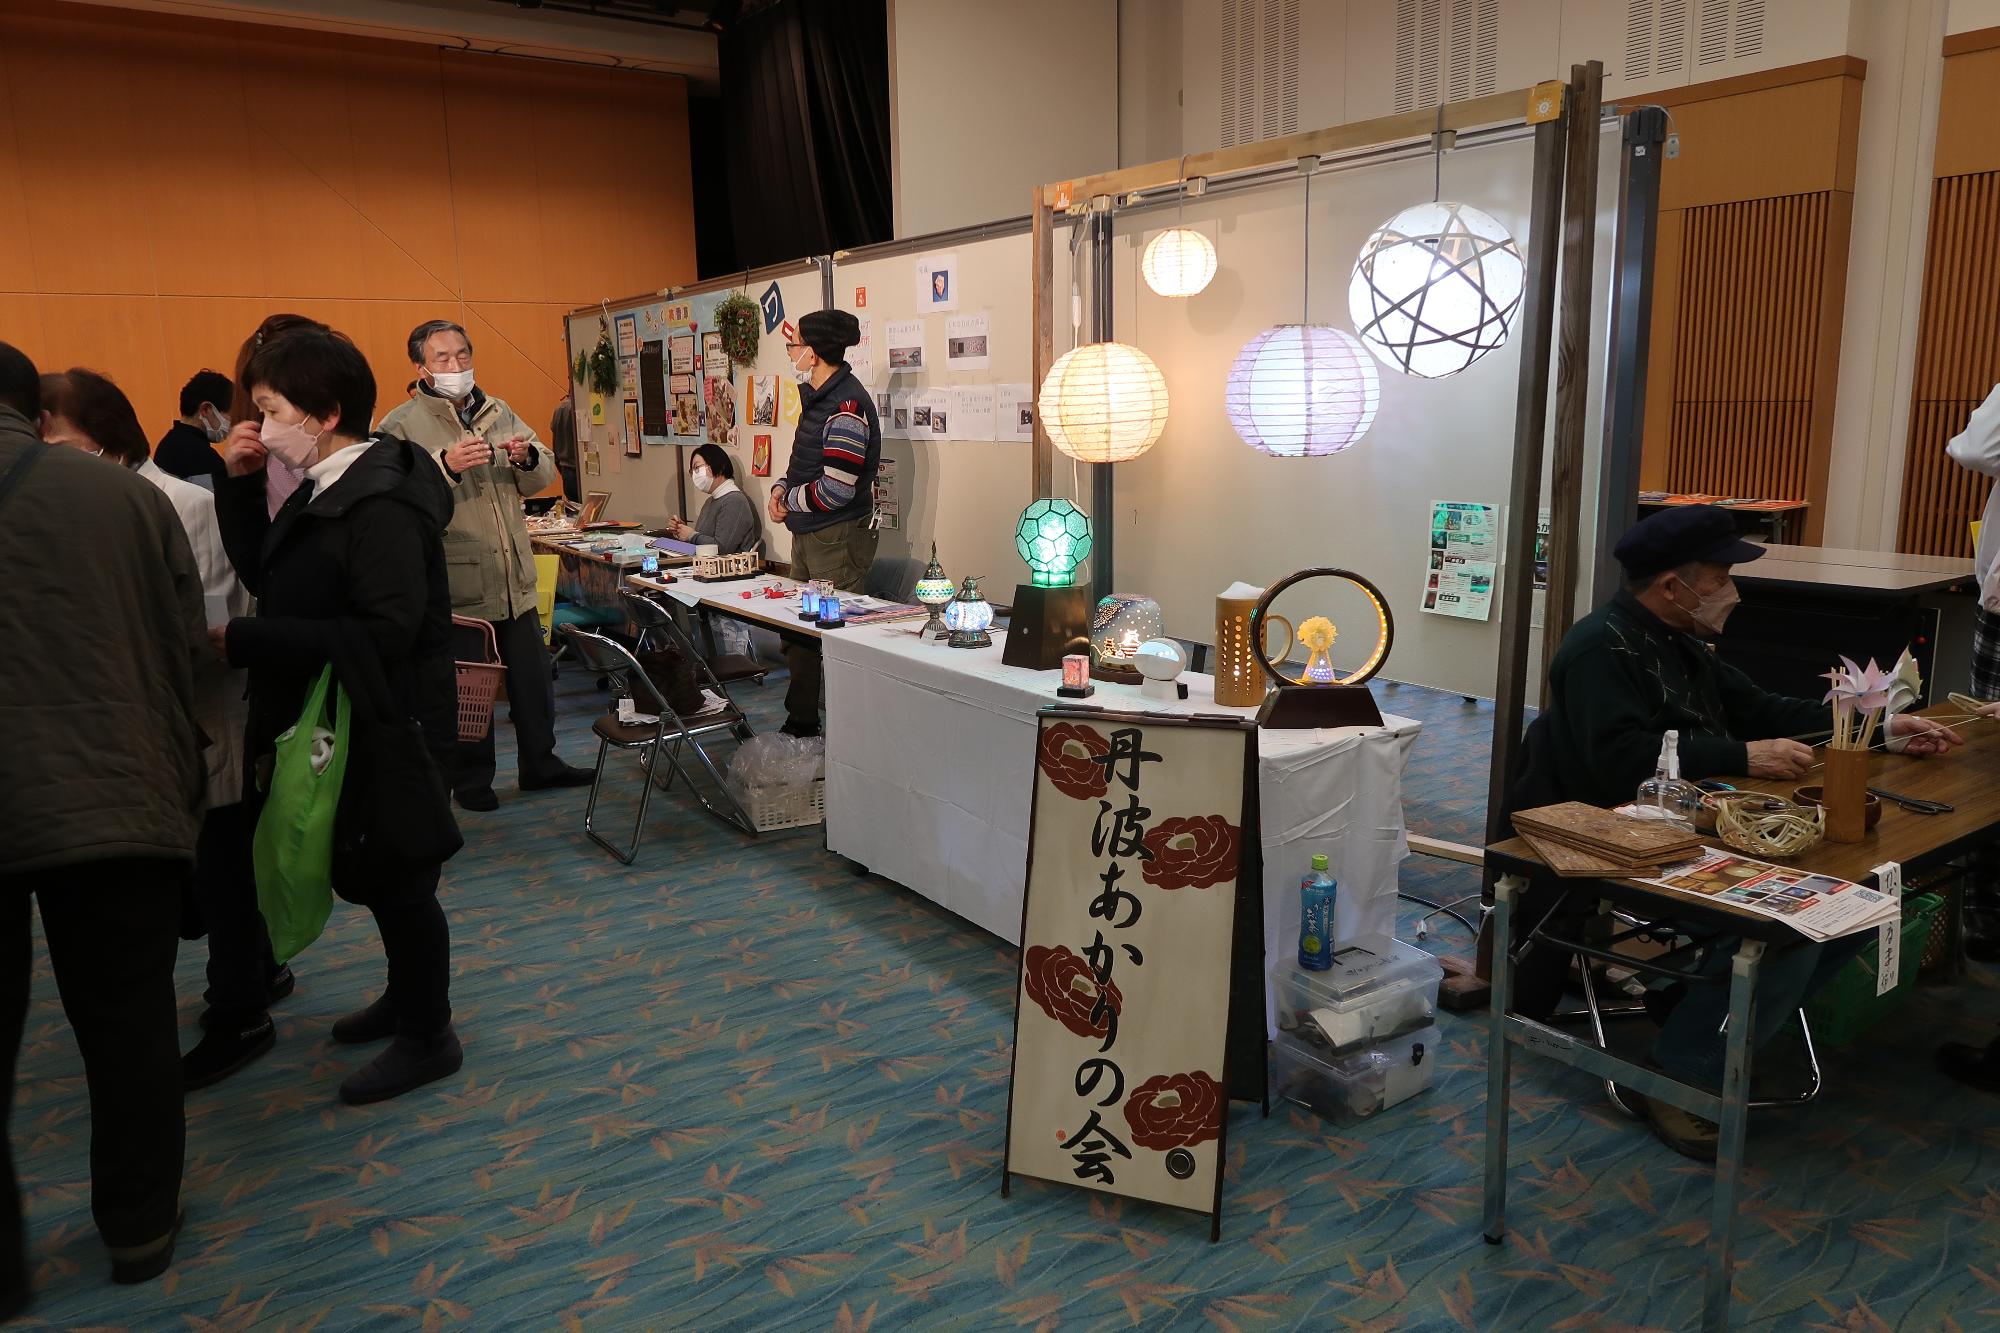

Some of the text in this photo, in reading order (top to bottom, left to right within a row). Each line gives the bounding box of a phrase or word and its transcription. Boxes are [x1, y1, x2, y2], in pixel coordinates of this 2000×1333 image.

[1059, 727, 1164, 1186] 丹波あかりの会
